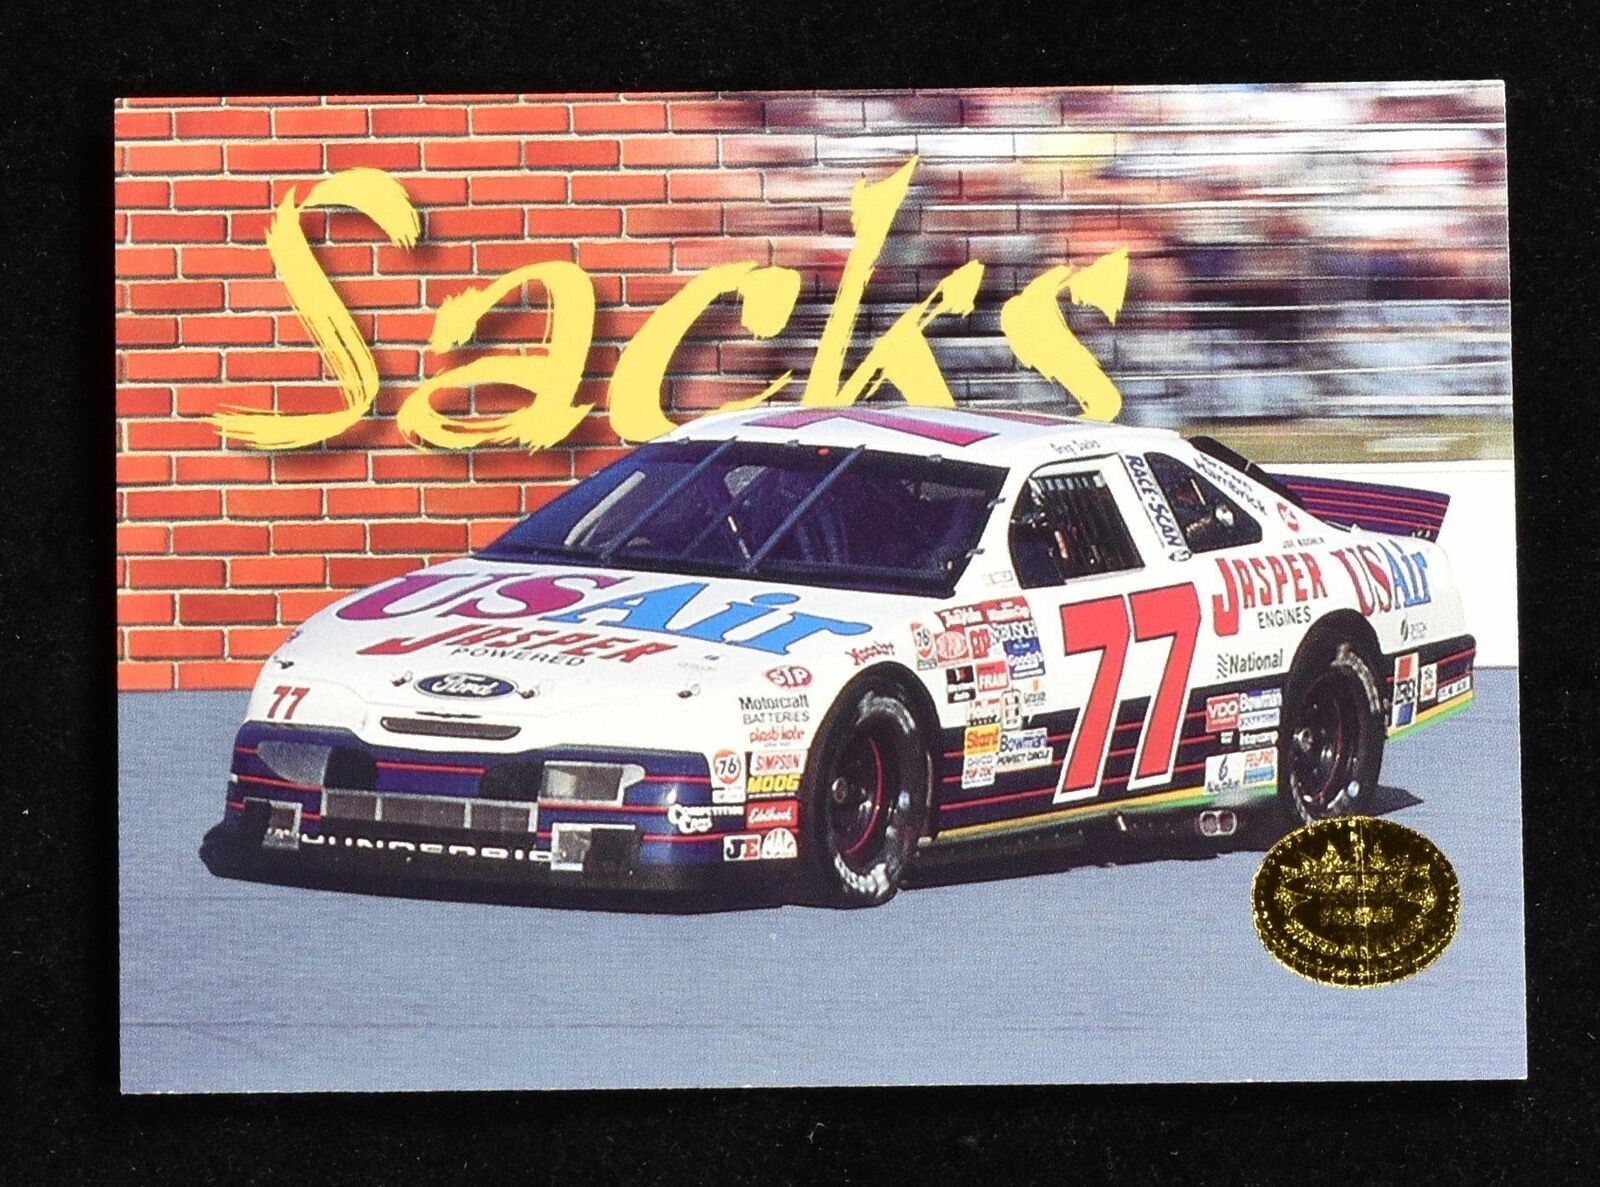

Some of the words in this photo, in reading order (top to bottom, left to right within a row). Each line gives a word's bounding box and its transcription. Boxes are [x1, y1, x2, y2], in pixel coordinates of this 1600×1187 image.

[207, 155, 1129, 453] Sacks
[1211, 551, 1329, 637] JASPER
[335, 572, 873, 655] USAir
[1257, 605, 1312, 630] ENGINES
[356, 623, 678, 664] JASPER
[450, 646, 586, 668] POWERED
[1229, 647, 1284, 675] National
[768, 667, 812, 688] STP
[266, 685, 311, 720] 77
[738, 694, 810, 711] Motorcraft
[1053, 580, 1202, 804] 77
[743, 711, 810, 725] BATTERIES
[1207, 700, 1239, 719] VDO
[718, 756, 738, 776] 76
[755, 753, 800, 771] SIMPSON
[747, 775, 800, 793] MOOG
[725, 838, 759, 859] JE
